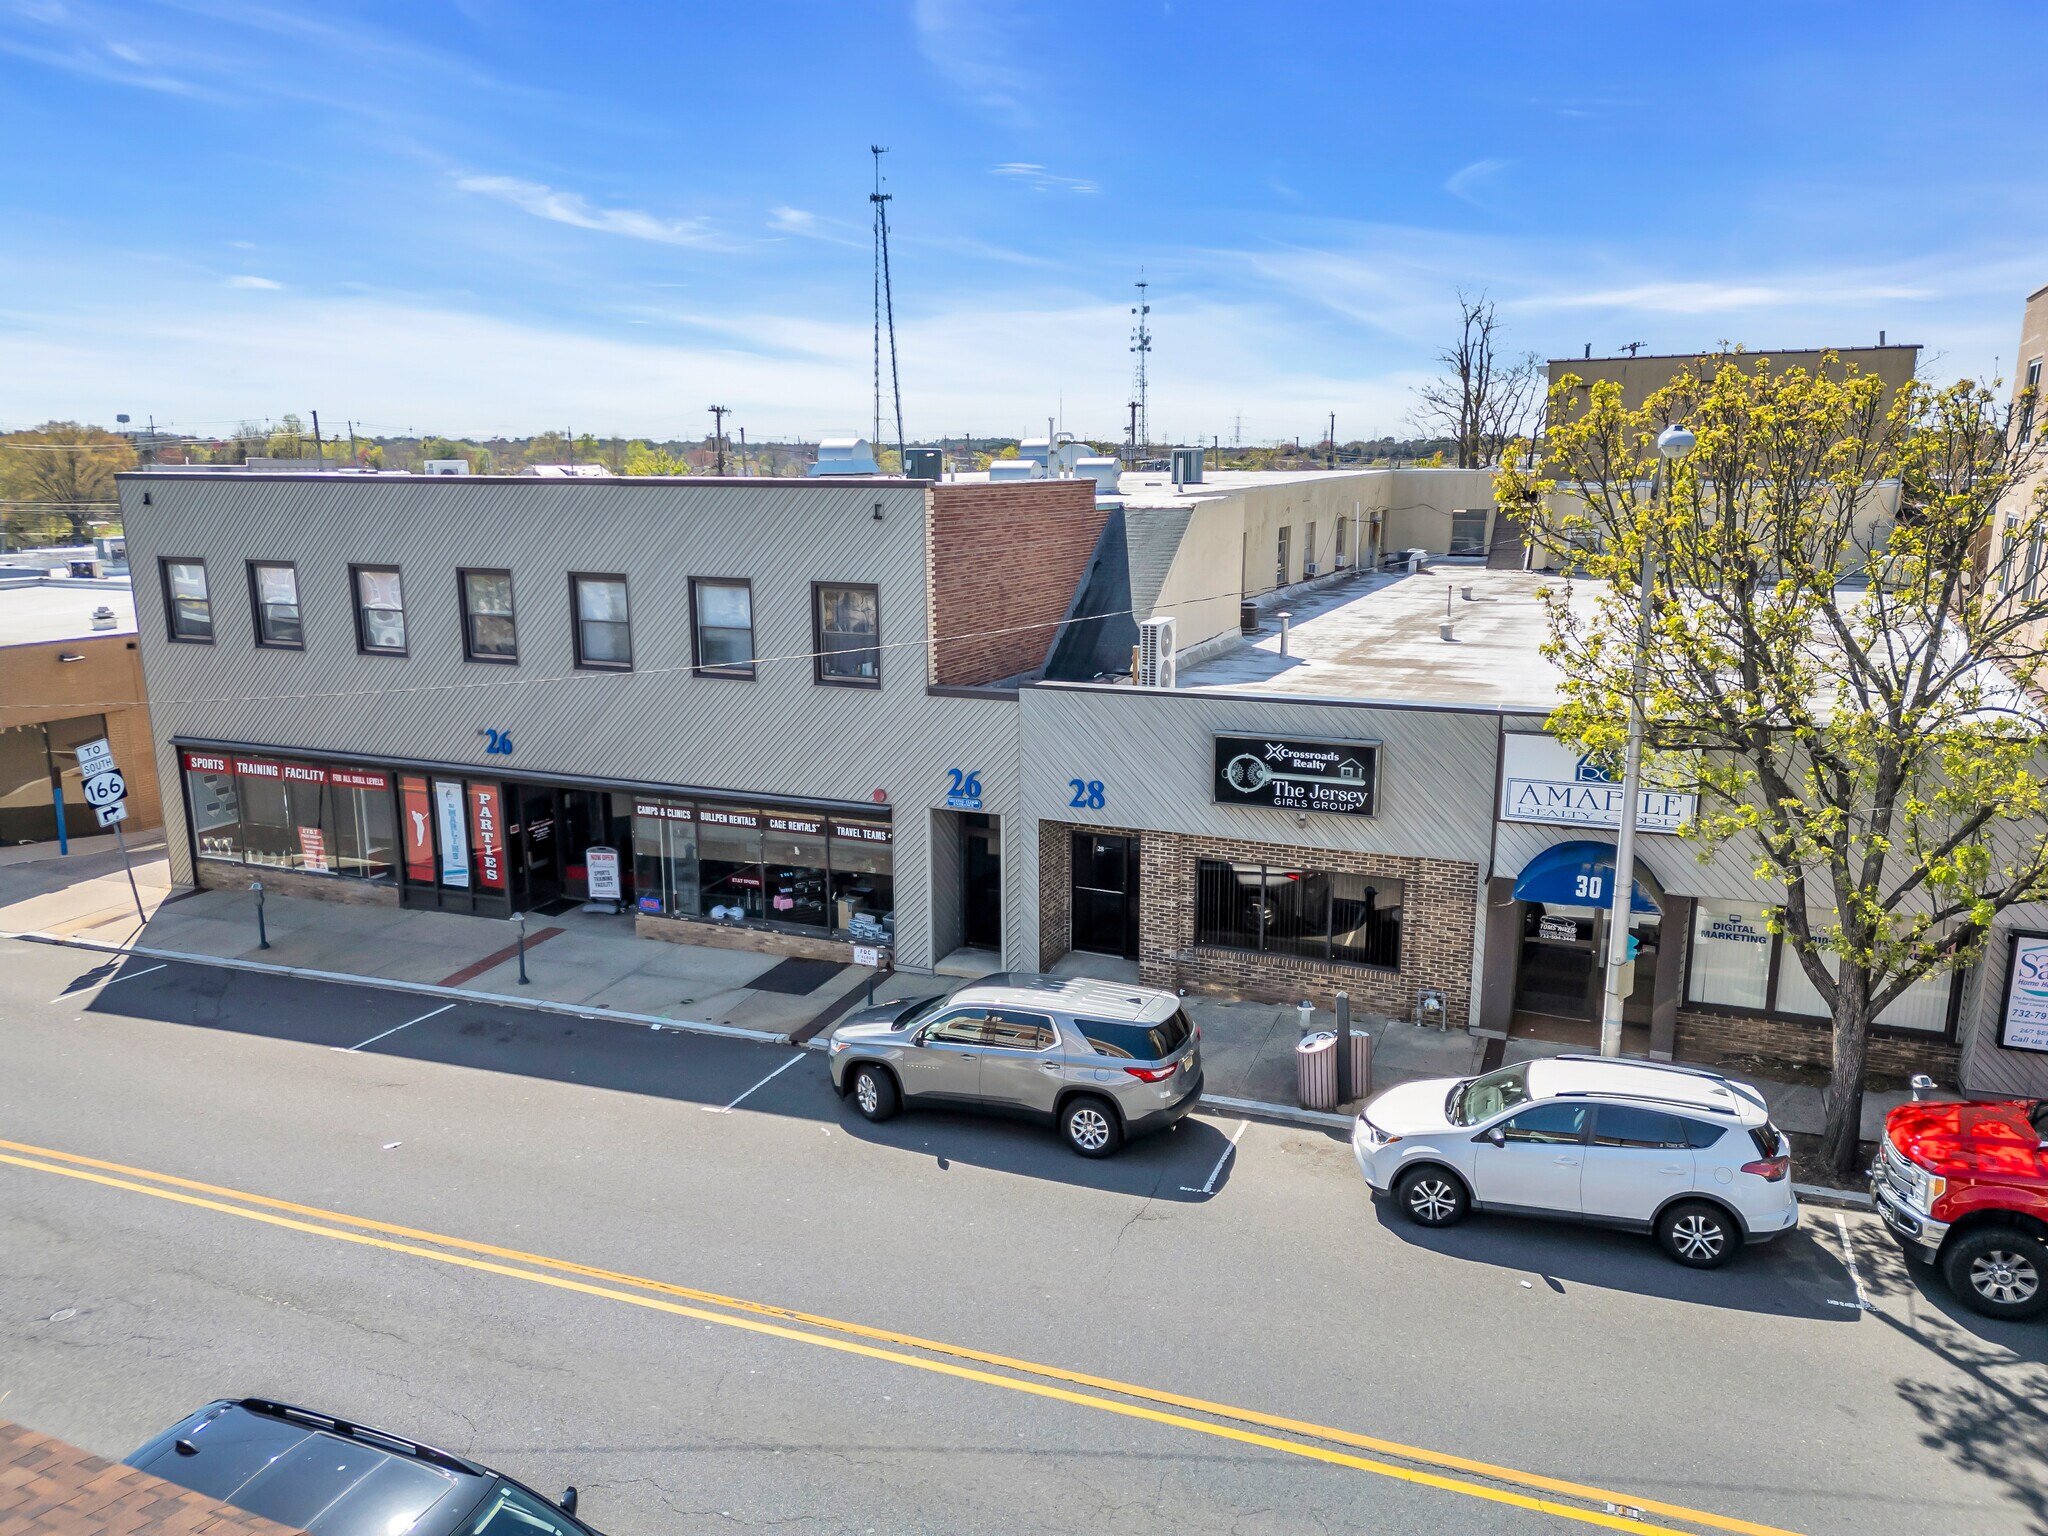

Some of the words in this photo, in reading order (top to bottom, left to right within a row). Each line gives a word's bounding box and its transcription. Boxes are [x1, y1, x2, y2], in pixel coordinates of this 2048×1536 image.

[485, 728, 513, 755] 26
[84, 745, 101, 757] TO
[1281, 749, 1340, 762] Crossroads
[84, 758, 113, 775] SOUTH
[191, 757, 224, 771] SPORTS
[237, 762, 278, 777] TRAINING
[285, 767, 325, 782] FACILITY
[1293, 759, 1326, 772] Realty
[332, 773, 342, 782] FOR
[343, 775, 352, 783] ALL
[352, 776, 366, 784] SKILL
[366, 777, 384, 786] LEVELS
[947, 768, 982, 798] 26
[88, 777, 121, 801] 166
[1068, 778, 1106, 810] 28
[1272, 780, 1305, 798] The
[1309, 784, 1369, 807] Jersey
[1274, 797, 1308, 808] GIRLS
[1312, 801, 1355, 812] GROUP
[1517, 783, 1682, 818] AMABLE
[637, 805, 659, 816] CAMPS
[660, 807, 666, 817] &
[667, 808, 691, 820] CLINICS
[700, 811, 728, 823] BULLPEN
[729, 814, 757, 827] RENTALS
[1517, 807, 1595, 820] REALTY
[769, 819, 787, 830] CAGE
[788, 821, 818, 833] RENTALS
[836, 826, 861, 838] TRAVEL
[863, 829, 886, 841] TEAMS
[478, 792, 498, 881] PARTIES
[1575, 875, 1602, 899] 30
[1712, 922, 1756, 934] DIGITAL
[1700, 930, 1767, 944] MARKETING
[2018, 979, 2040, 987] Home
[2011, 1034, 2029, 1044] Call
